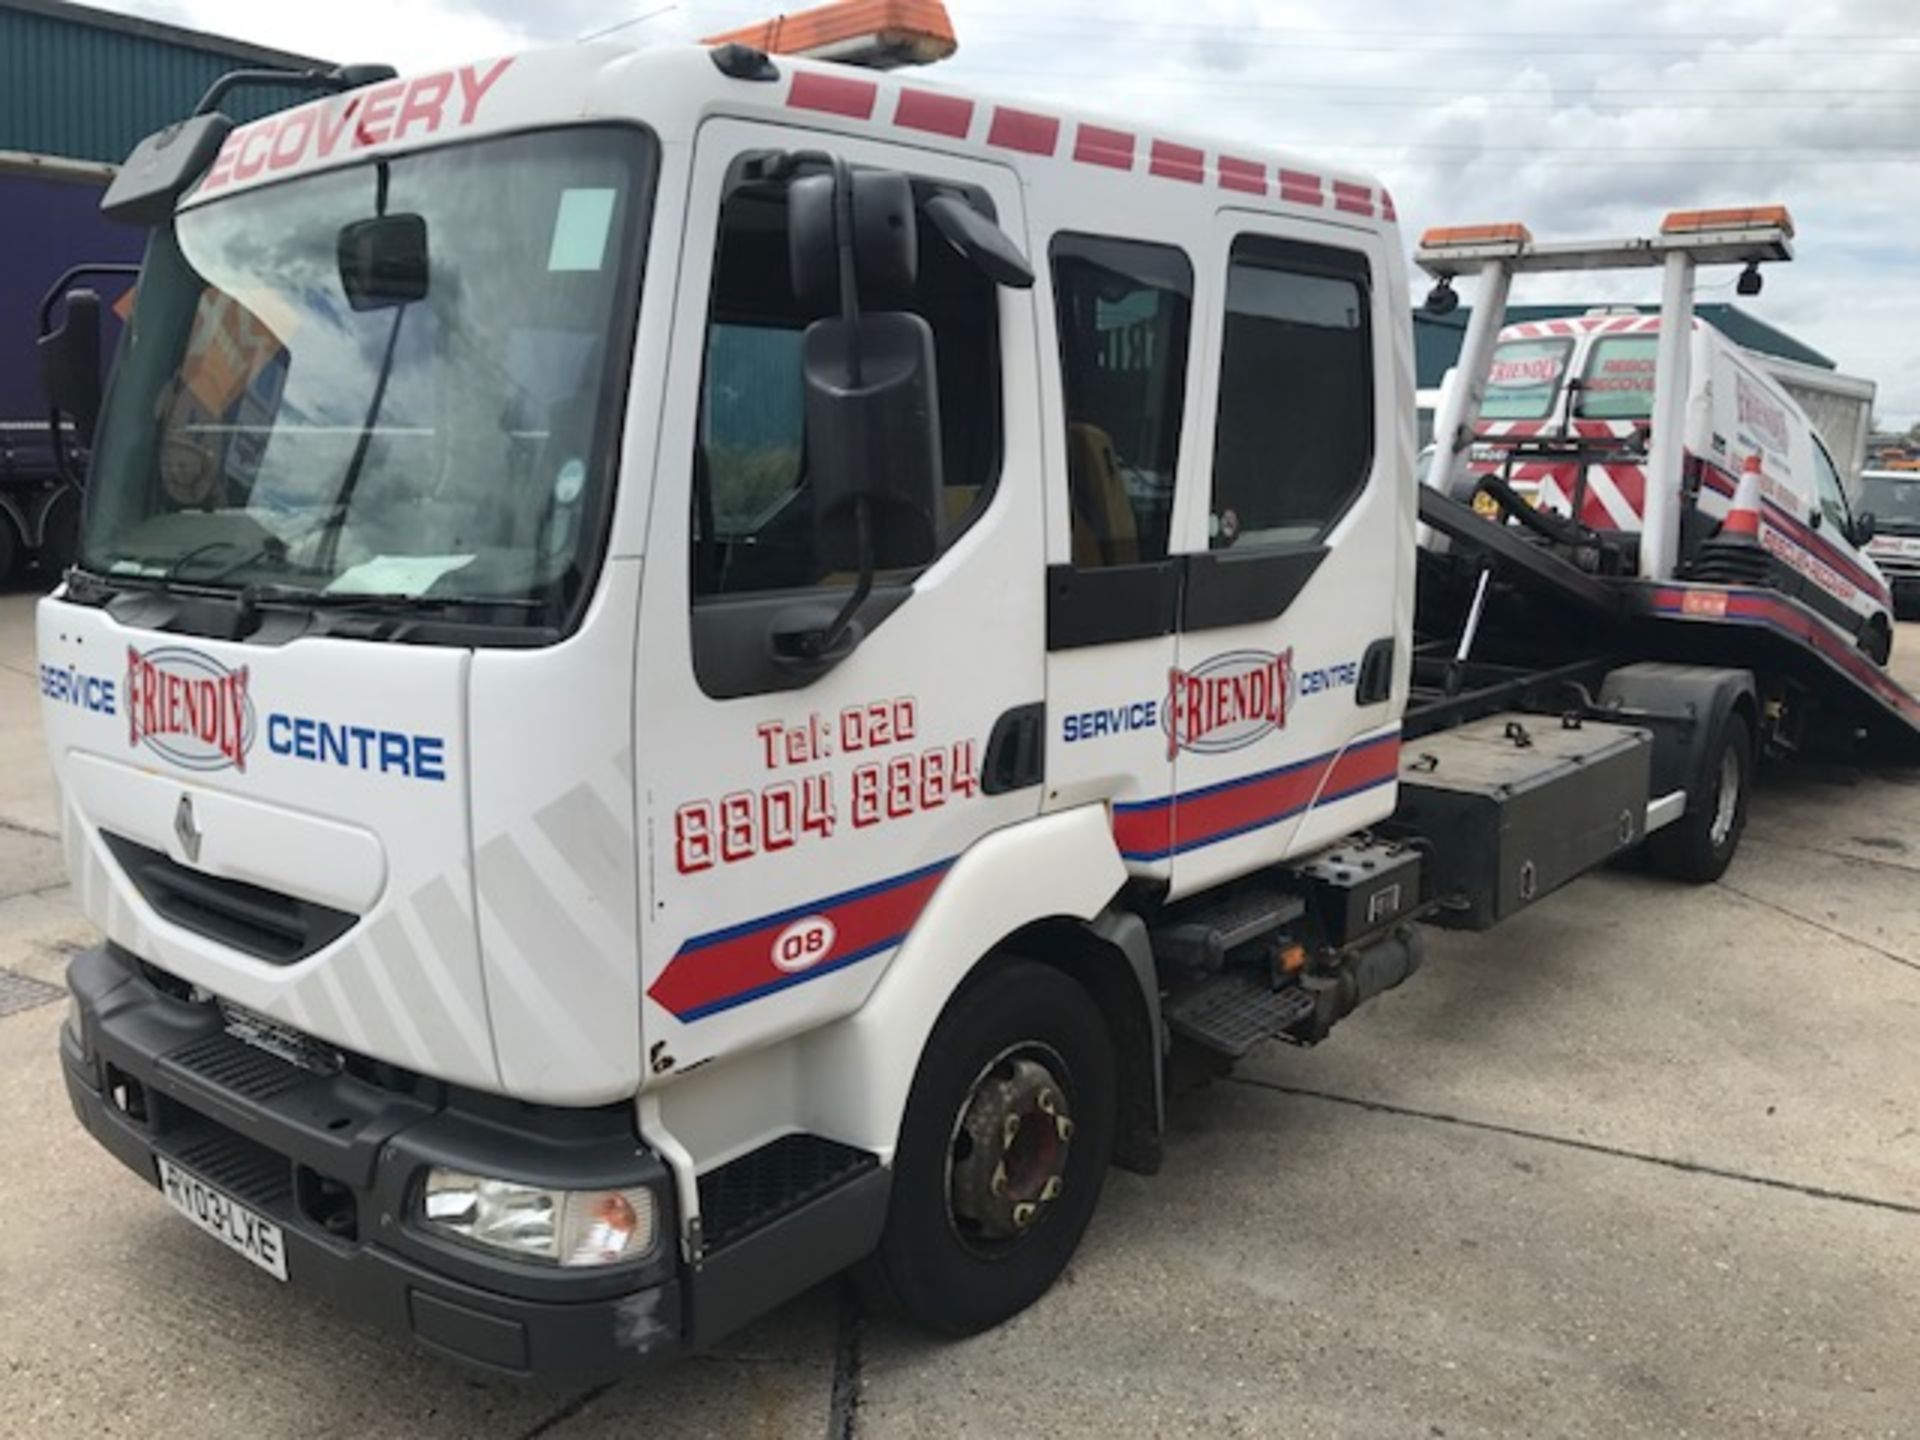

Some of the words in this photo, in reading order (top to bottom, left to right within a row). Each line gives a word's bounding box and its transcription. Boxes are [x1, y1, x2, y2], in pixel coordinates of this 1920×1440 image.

[41, 664, 116, 714] SERVICE
[127, 643, 250, 774] FRIENDLY
[267, 713, 446, 781] CENTRE
[757, 713, 832, 769] Tel:
[840, 698, 914, 753] 020
[1063, 701, 1156, 743] SERVICE
[1167, 646, 1293, 762] FRIENDLY
[1301, 662, 1357, 695] CENTRE
[675, 772, 836, 875] 8804
[851, 739, 978, 829] 8884
[782, 929, 824, 961] 08
